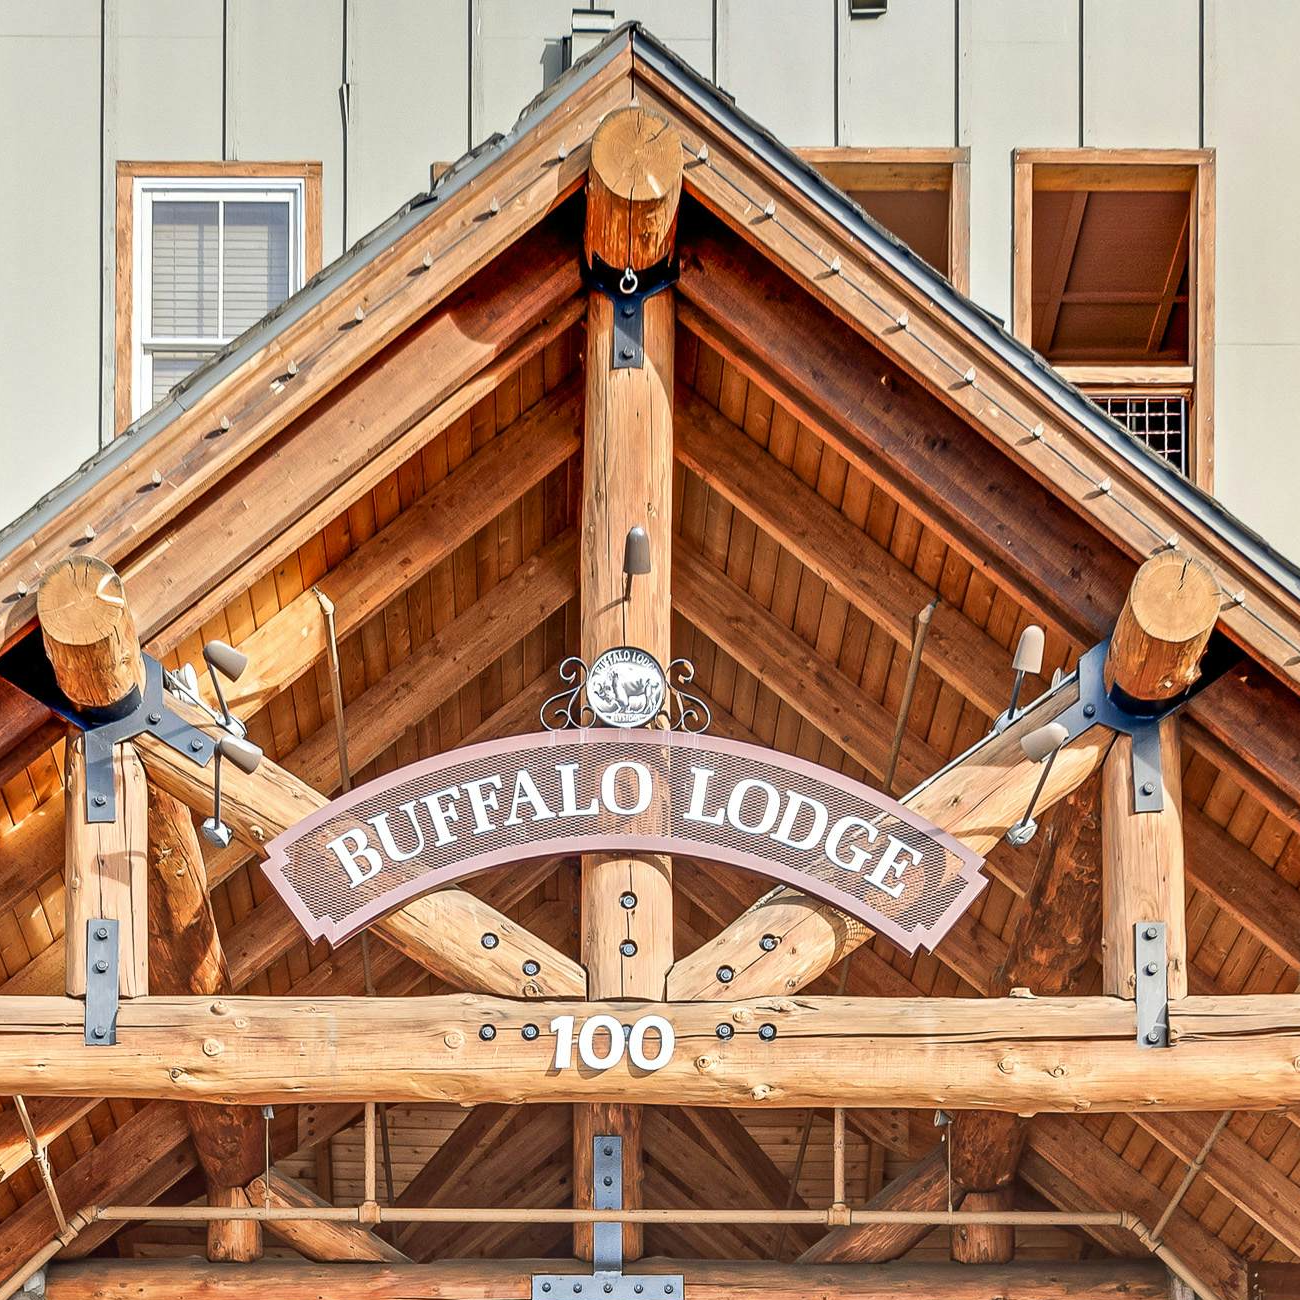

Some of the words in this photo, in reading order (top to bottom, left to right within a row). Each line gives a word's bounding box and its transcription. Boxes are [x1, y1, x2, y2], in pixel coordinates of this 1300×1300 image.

[325, 761, 653, 889] BUFFALO
[683, 766, 924, 899] LODGE
[550, 1014, 676, 1071] 100
